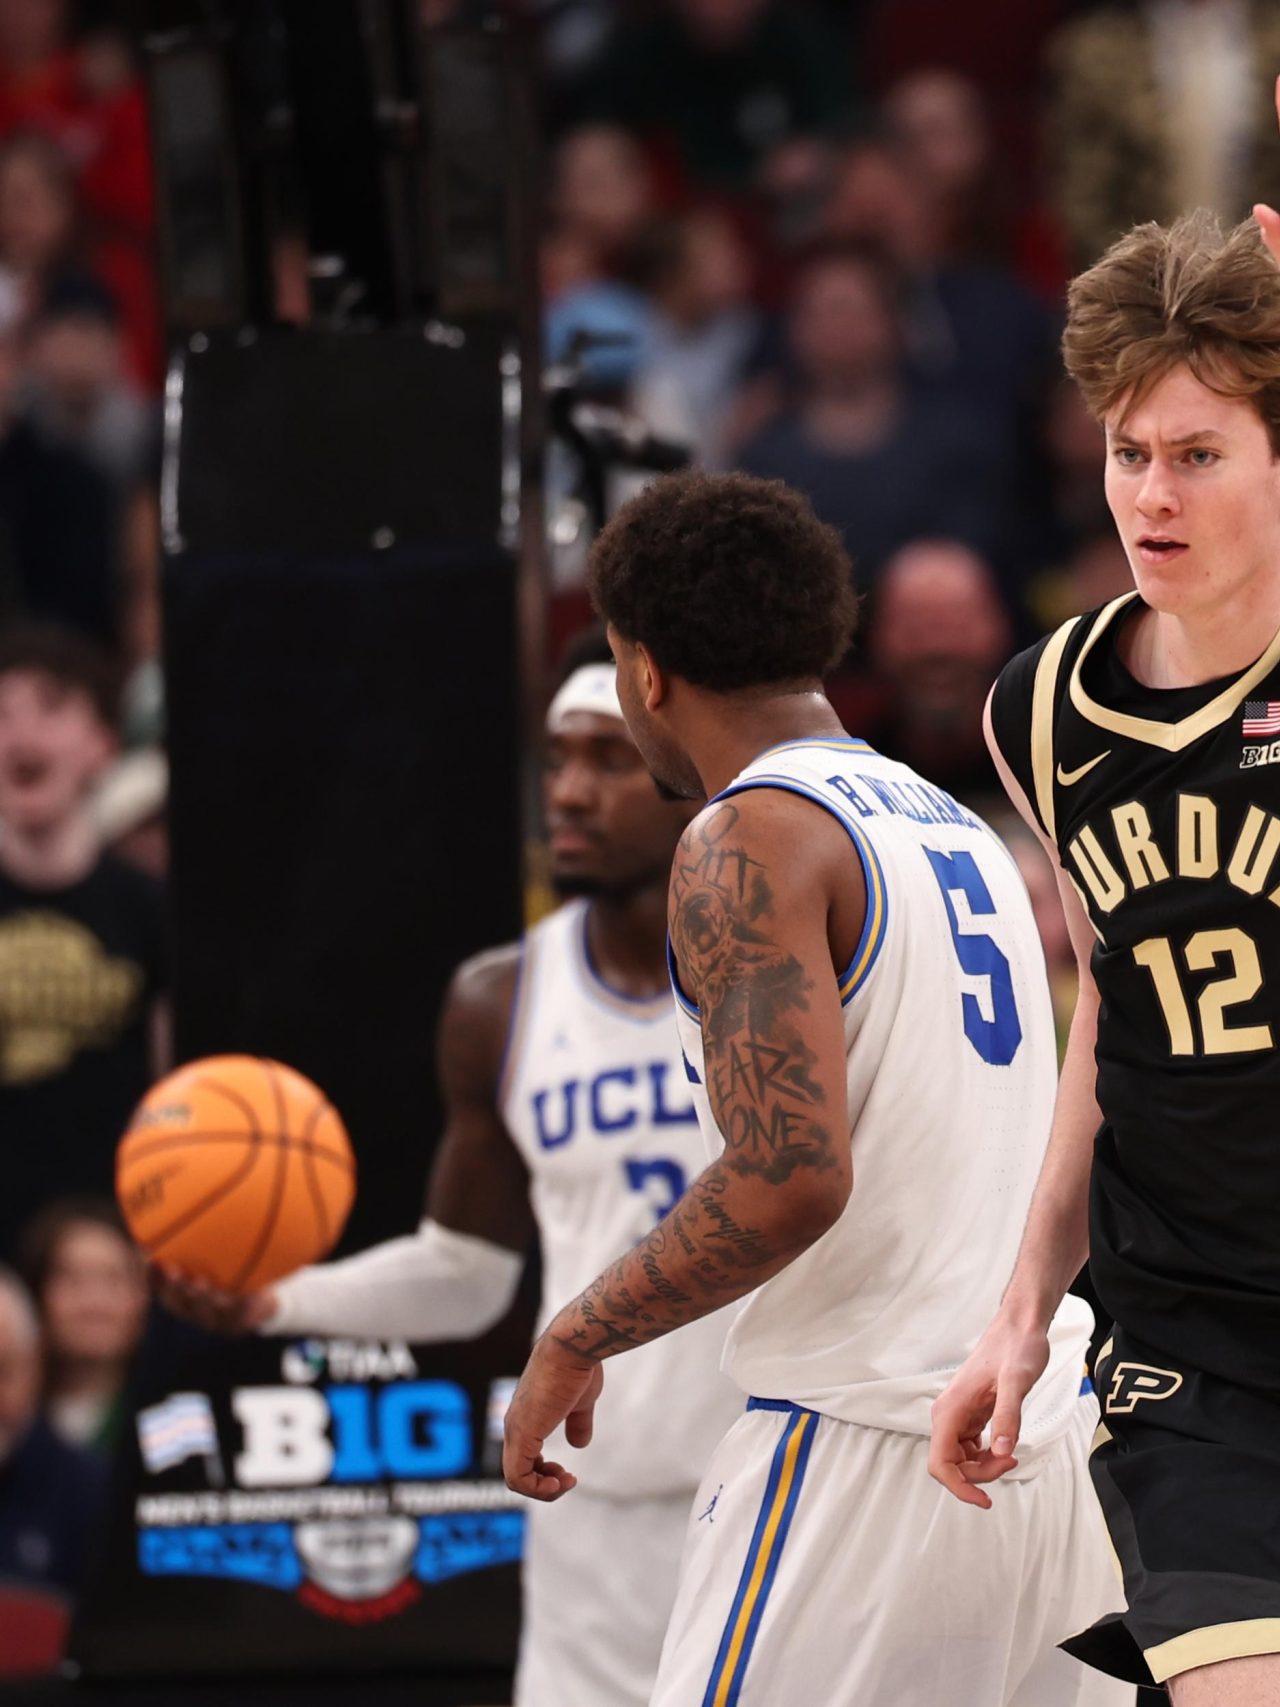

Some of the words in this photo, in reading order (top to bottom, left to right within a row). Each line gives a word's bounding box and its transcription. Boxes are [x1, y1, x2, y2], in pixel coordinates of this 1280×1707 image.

[921, 844, 1022, 1066] 5
[1132, 927, 1274, 1055] 12
[533, 1062, 700, 1150] UCL
[1106, 1362, 1183, 1413] P
